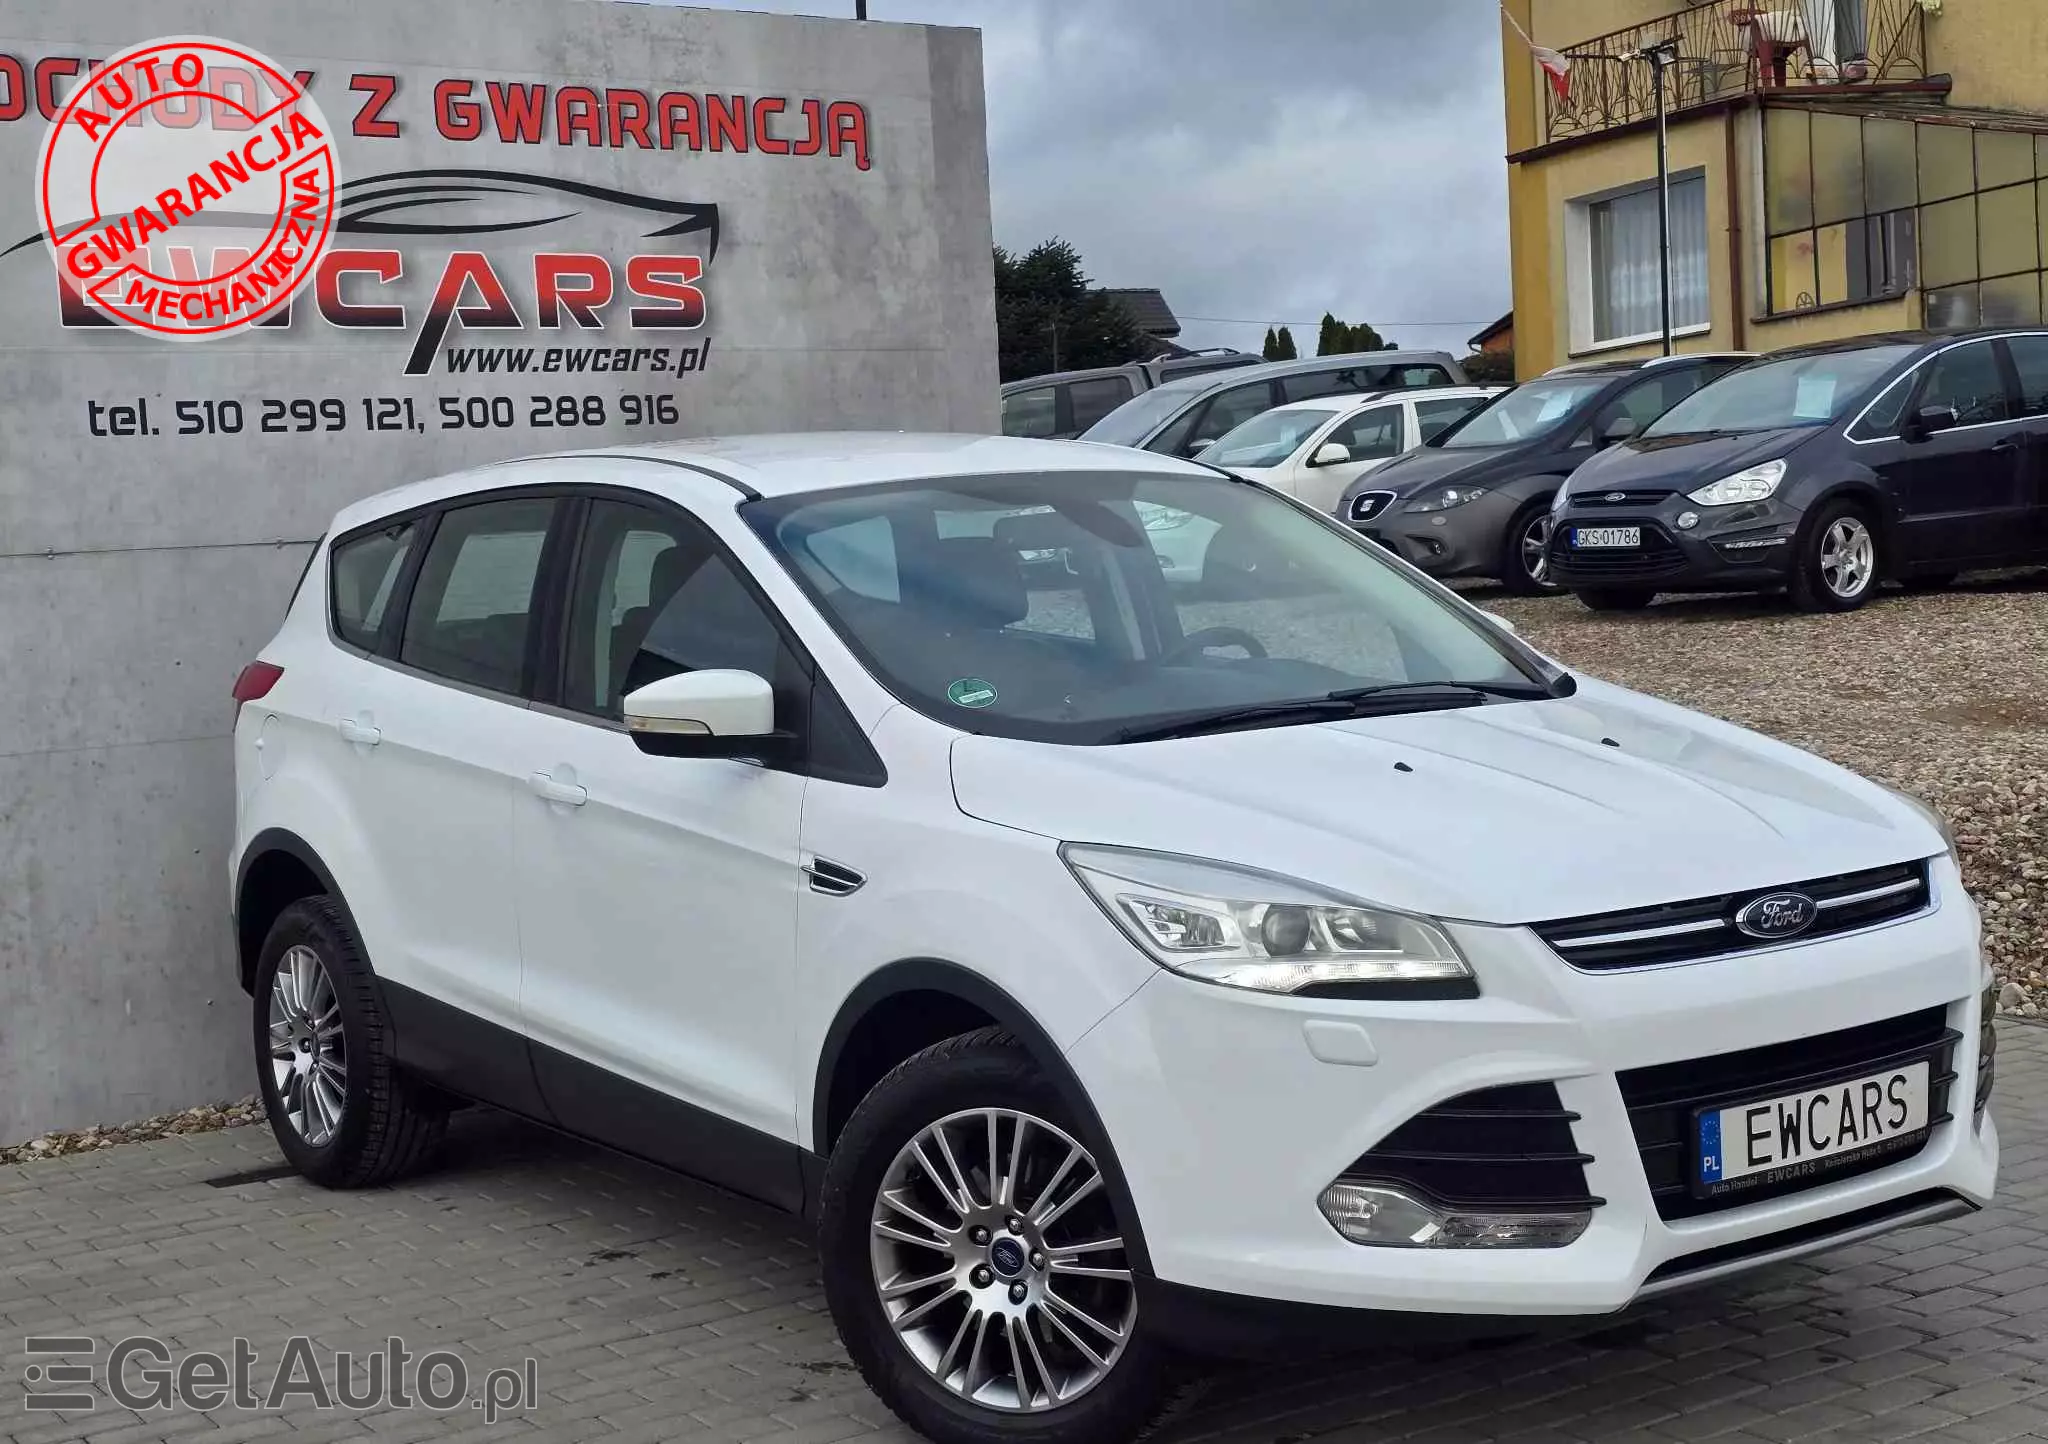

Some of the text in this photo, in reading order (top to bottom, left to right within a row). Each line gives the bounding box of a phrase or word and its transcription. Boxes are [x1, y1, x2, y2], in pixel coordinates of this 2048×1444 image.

[350, 72, 400, 138] Z
[434, 79, 871, 171] GWARANCJĄ
[55, 245, 706, 376] EWCARS
[447, 337, 711, 379] www.ewcars.pl
[88, 394, 679, 436] tel. 510 299 121, 500 288 916
[1602, 529, 1639, 545] 01786
[1761, 899, 1803, 928] Ford
[1746, 1074, 1908, 1167] EWCARS
[1703, 1156, 1721, 1173] PL
[1767, 1162, 1816, 1184] EWCARS
